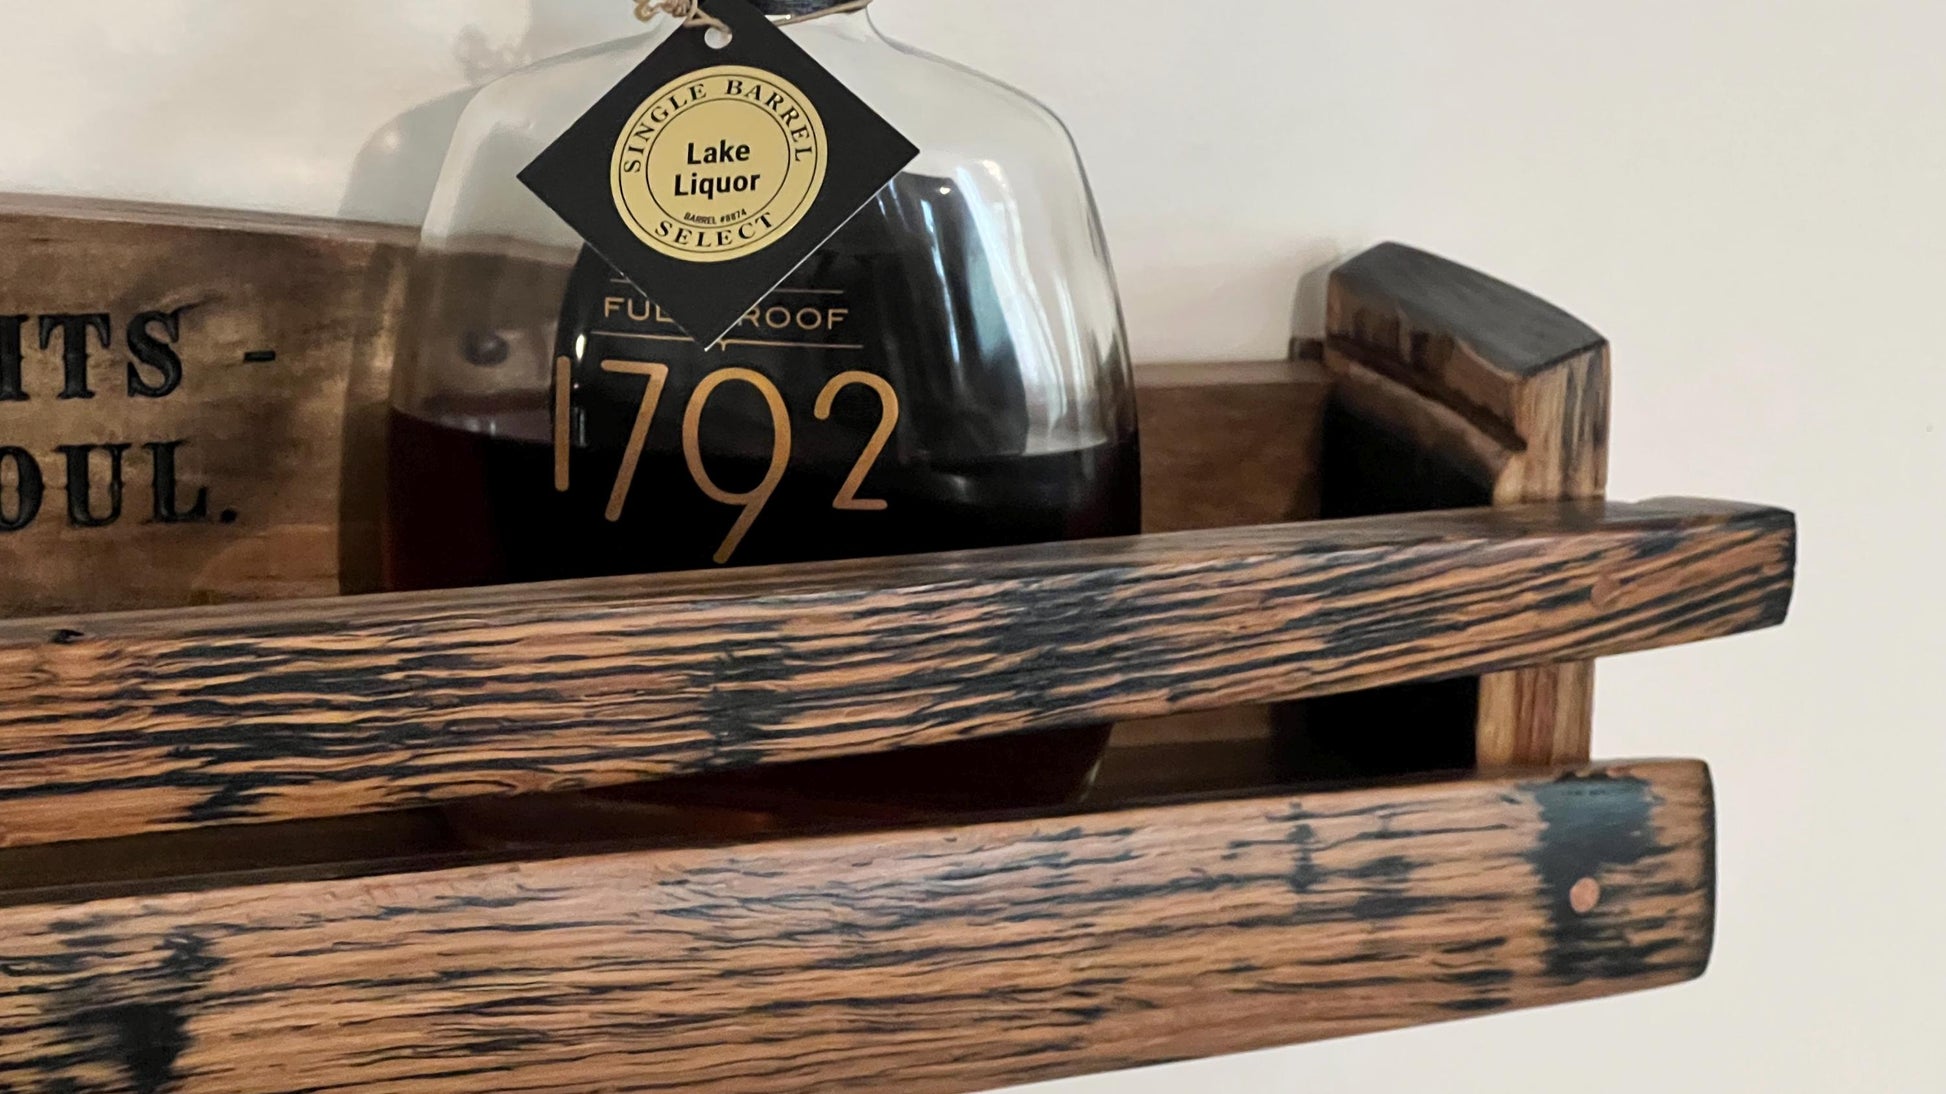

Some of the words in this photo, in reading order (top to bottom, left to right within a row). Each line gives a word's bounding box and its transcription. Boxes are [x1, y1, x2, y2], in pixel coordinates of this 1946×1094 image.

[624, 83, 707, 174] SINGLE
[724, 80, 812, 162] BARREL
[687, 139, 751, 165] Lake
[674, 172, 761, 200] Liquor
[654, 211, 774, 248] SELECT
[683, 211, 717, 225] BARREL
[604, 296, 674, 323] FUL
[735, 305, 849, 330] ROOF
[554, 355, 900, 564] 1792
